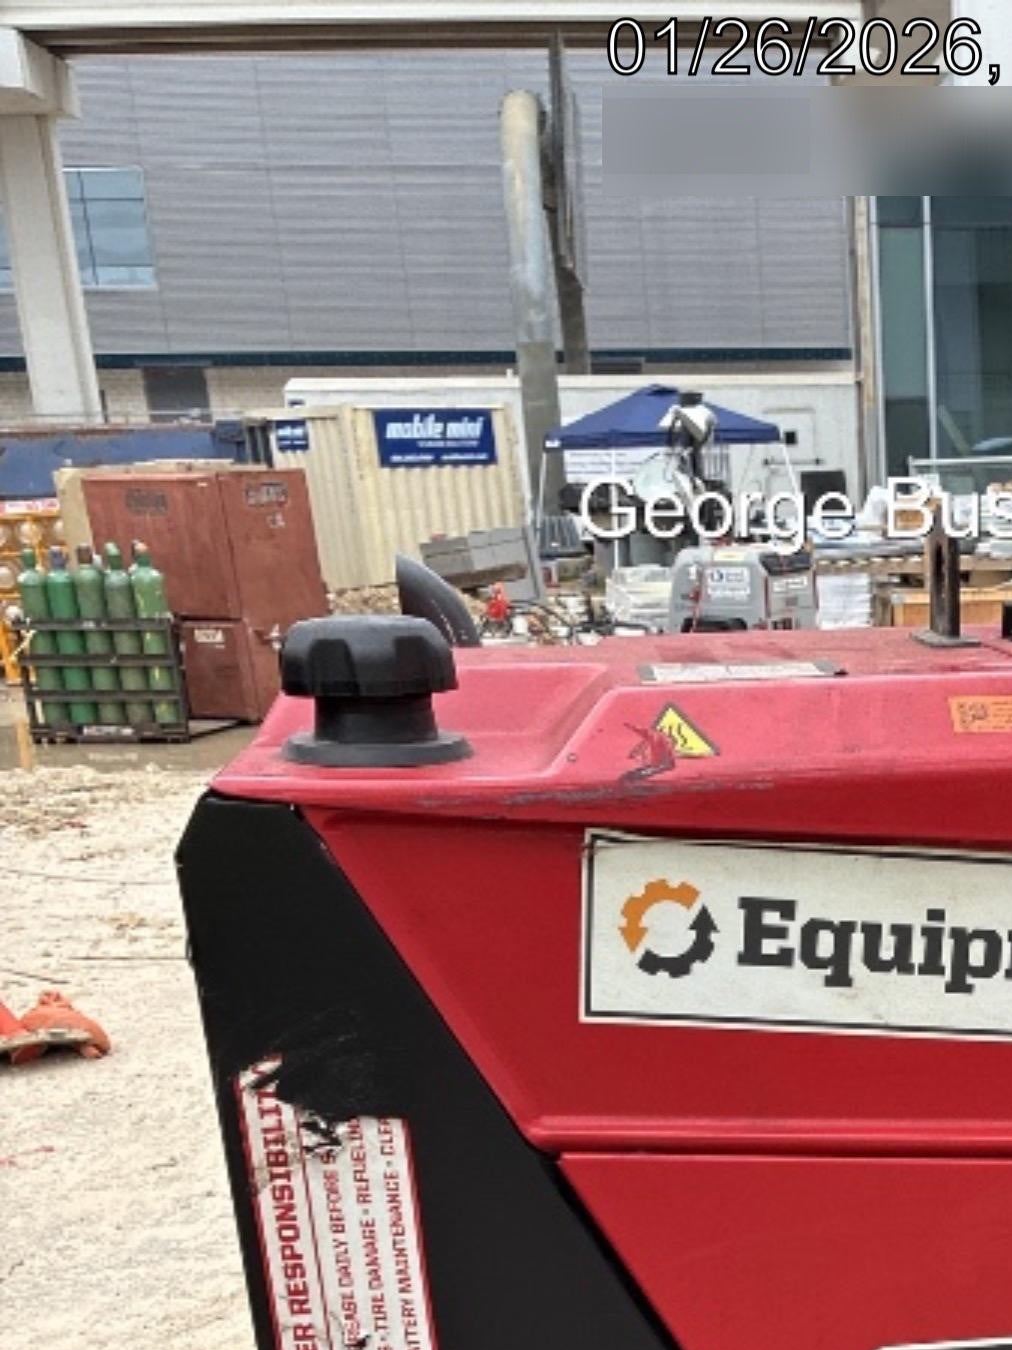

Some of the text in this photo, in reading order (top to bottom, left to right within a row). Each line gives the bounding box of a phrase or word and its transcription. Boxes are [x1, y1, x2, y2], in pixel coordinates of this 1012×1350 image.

[384, 412, 485, 440] mobile mini
[323, 1171, 346, 1233] BEFORE
[383, 1166, 413, 1292] MAINTENANCE
[333, 1239, 354, 1287] DAILY
[359, 1218, 383, 1289] DAMAGE
[370, 1293, 389, 1331] TIRE
